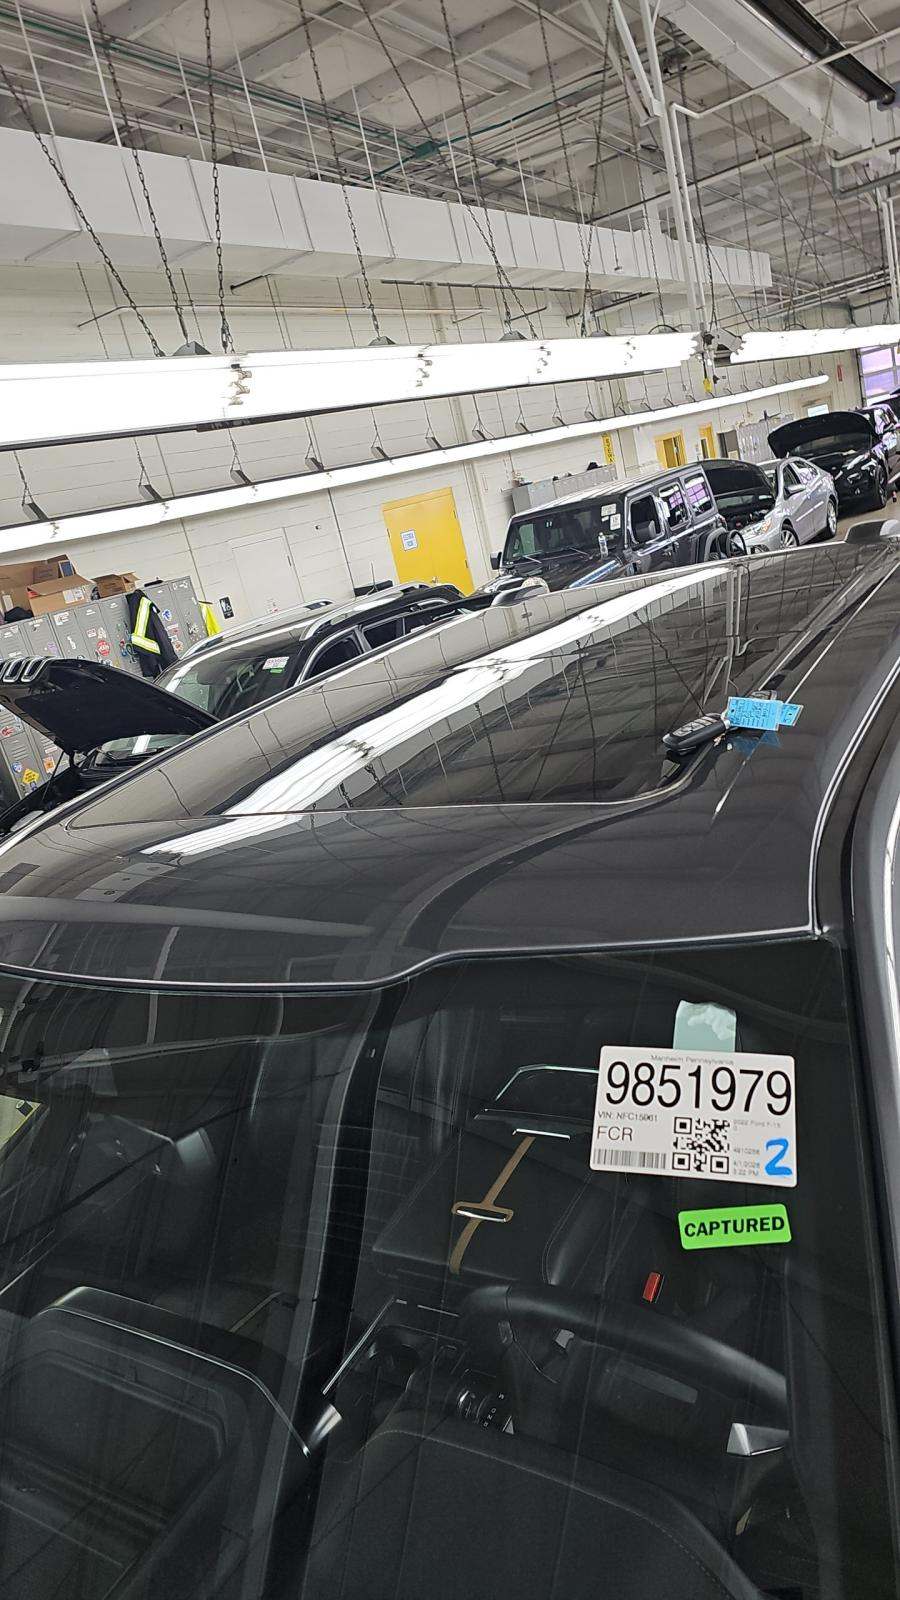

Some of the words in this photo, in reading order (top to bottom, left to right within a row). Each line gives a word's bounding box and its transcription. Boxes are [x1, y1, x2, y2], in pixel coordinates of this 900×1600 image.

[606, 1061, 791, 1115] 9851979
[597, 1111, 616, 1120] VIN:
[597, 1125, 633, 1142] FCR
[765, 1138, 793, 1176] 2
[684, 1216, 785, 1237] CAPTURED
